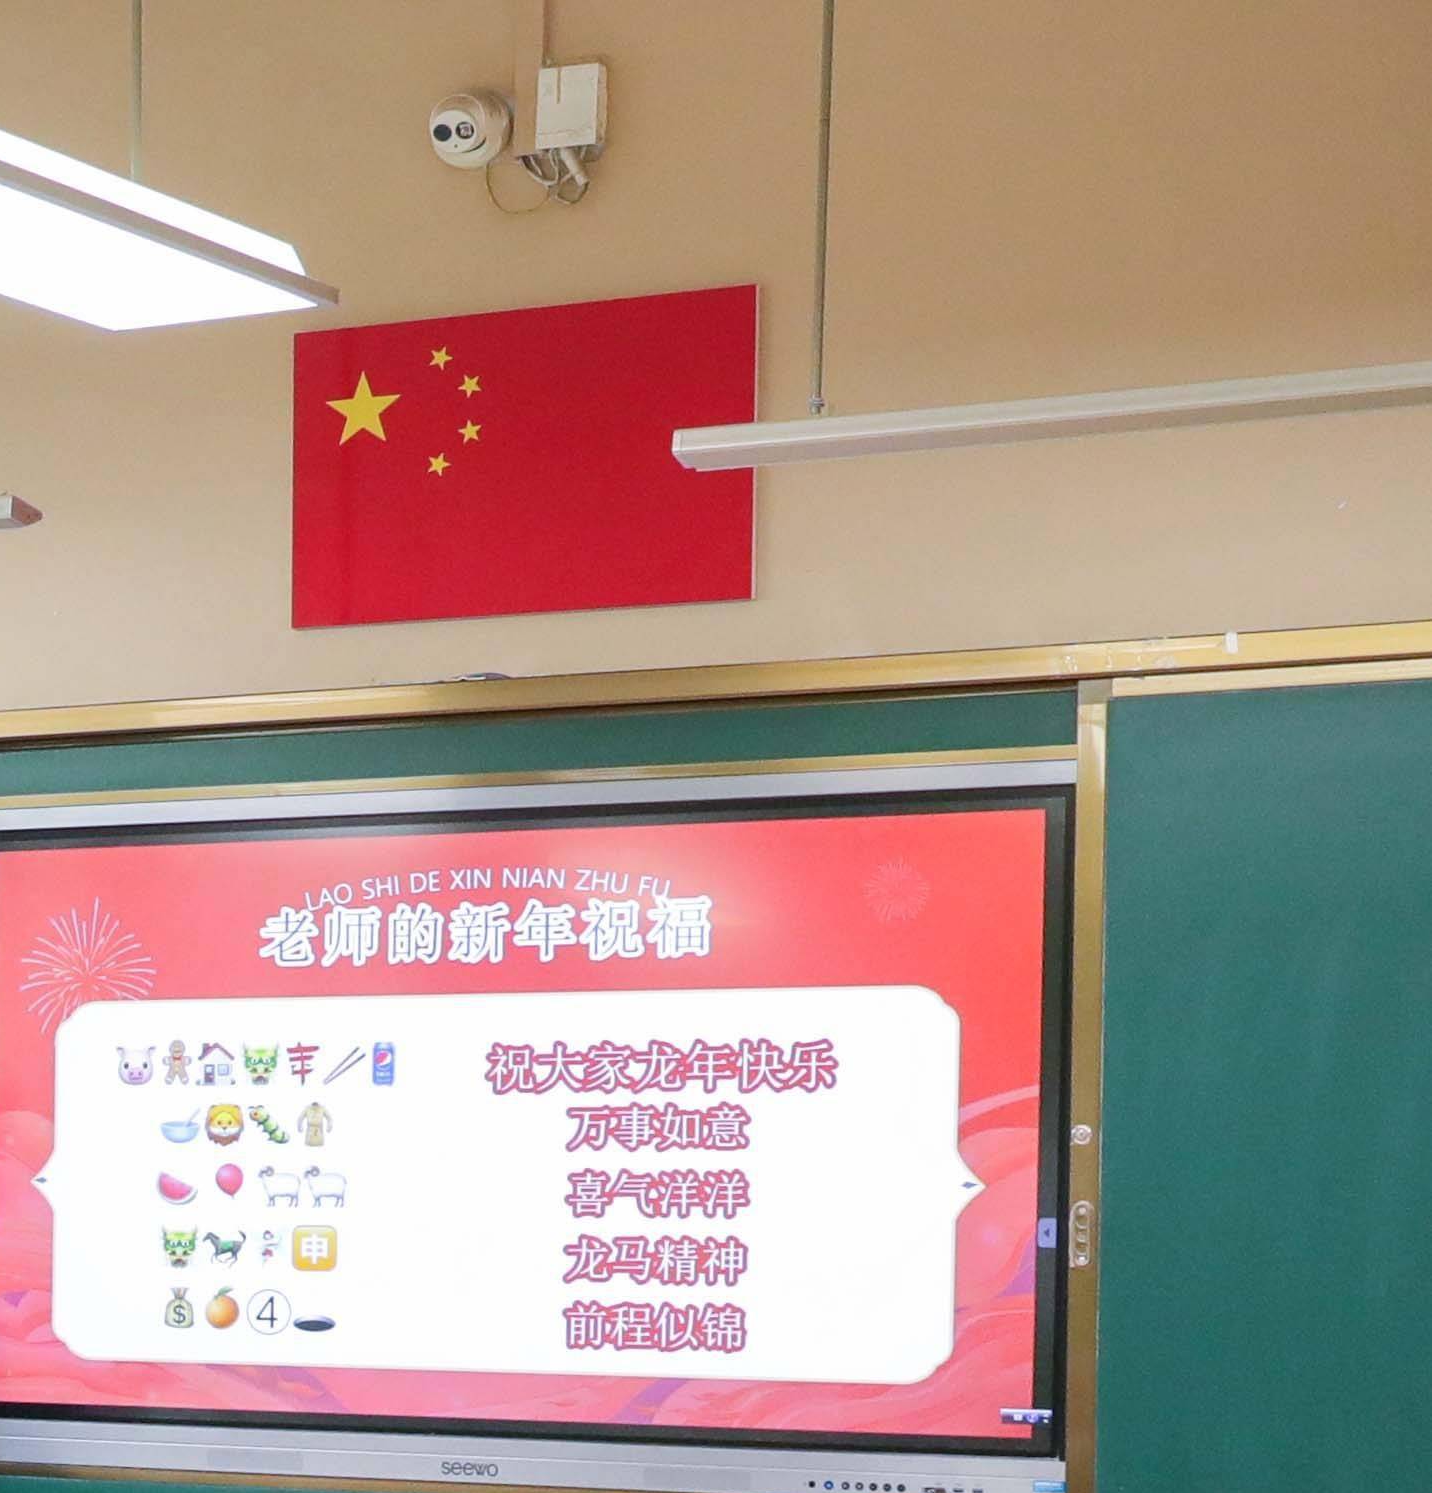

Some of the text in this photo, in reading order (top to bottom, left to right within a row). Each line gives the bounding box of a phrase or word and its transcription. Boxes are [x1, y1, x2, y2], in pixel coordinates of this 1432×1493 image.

[304, 867, 671, 912] LAO SHI DE XIN NIAN ZHU FU
[259, 895, 713, 968] 老师的新年祝福
[485, 1039, 839, 1095] 祝大家龙年快乐
[566, 1102, 751, 1152] 万事如意
[565, 1168, 750, 1220] 喜气洋洋
[563, 1235, 747, 1286] 龙马精神
[563, 1300, 747, 1353] 前程似锦
[441, 1461, 499, 1477] seewo
